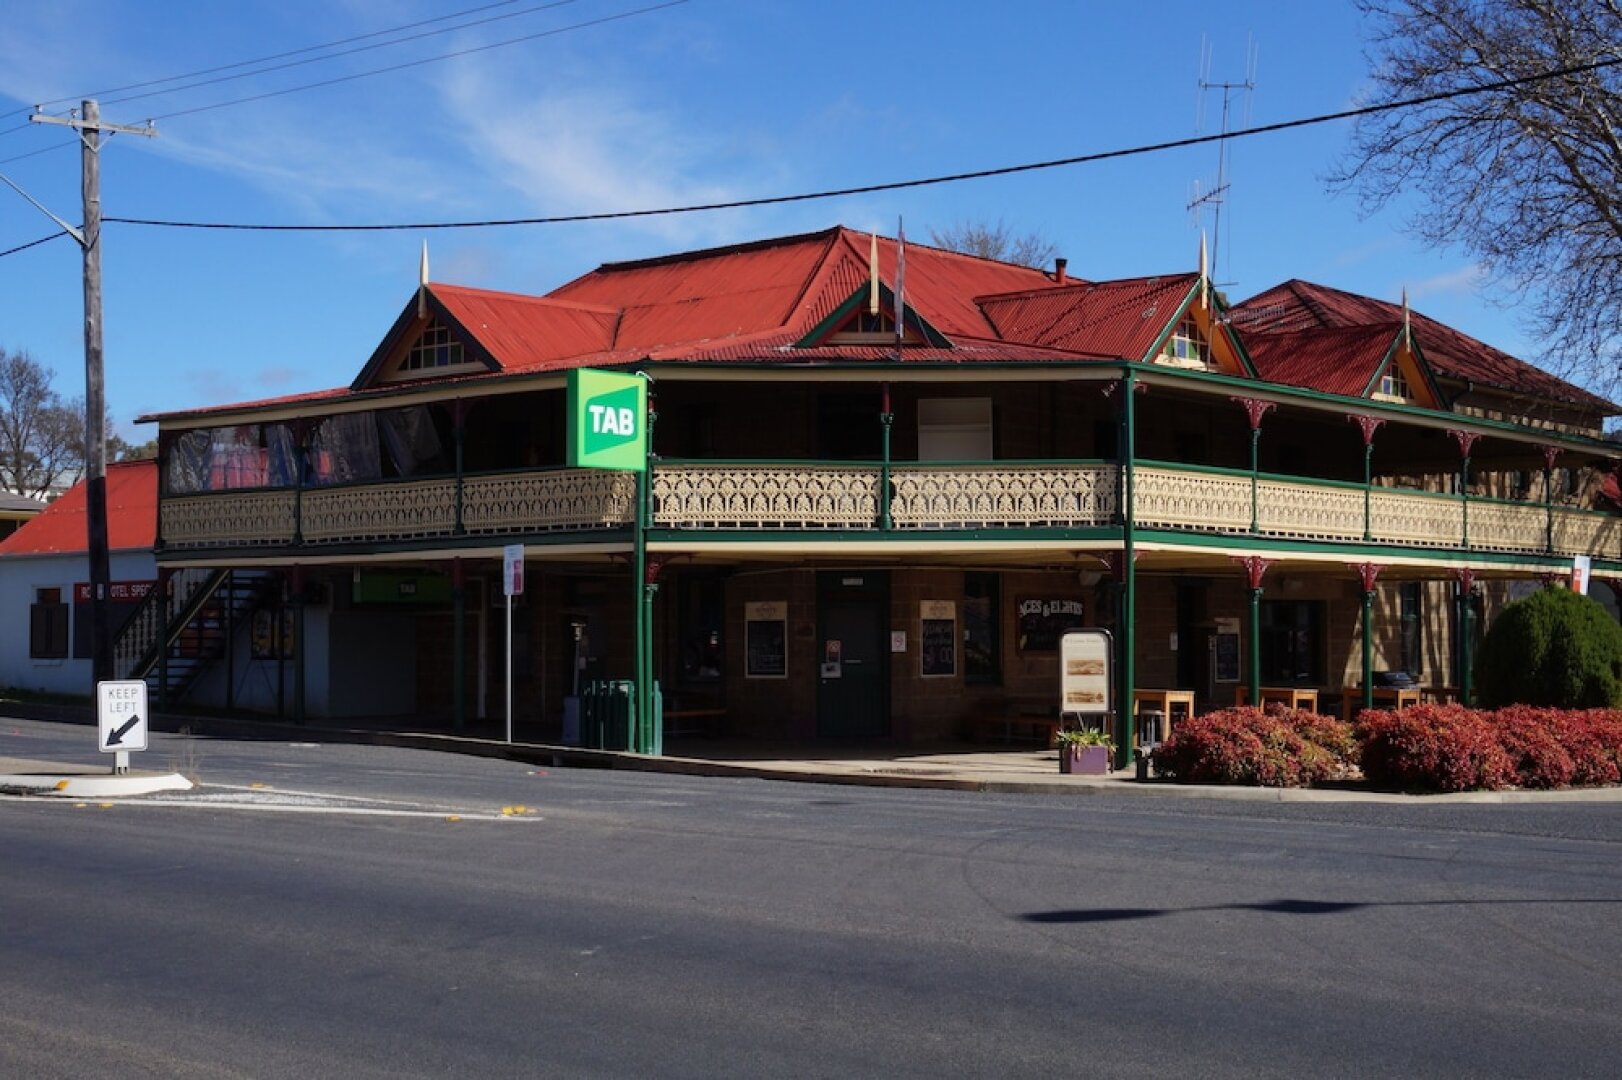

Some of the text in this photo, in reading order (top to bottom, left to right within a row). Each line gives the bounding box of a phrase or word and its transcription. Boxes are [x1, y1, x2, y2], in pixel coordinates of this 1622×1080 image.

[588, 404, 635, 436] TAB
[110, 584, 129, 598] OTEL
[108, 687, 138, 699] KEEP
[109, 701, 137, 713] LEFT
